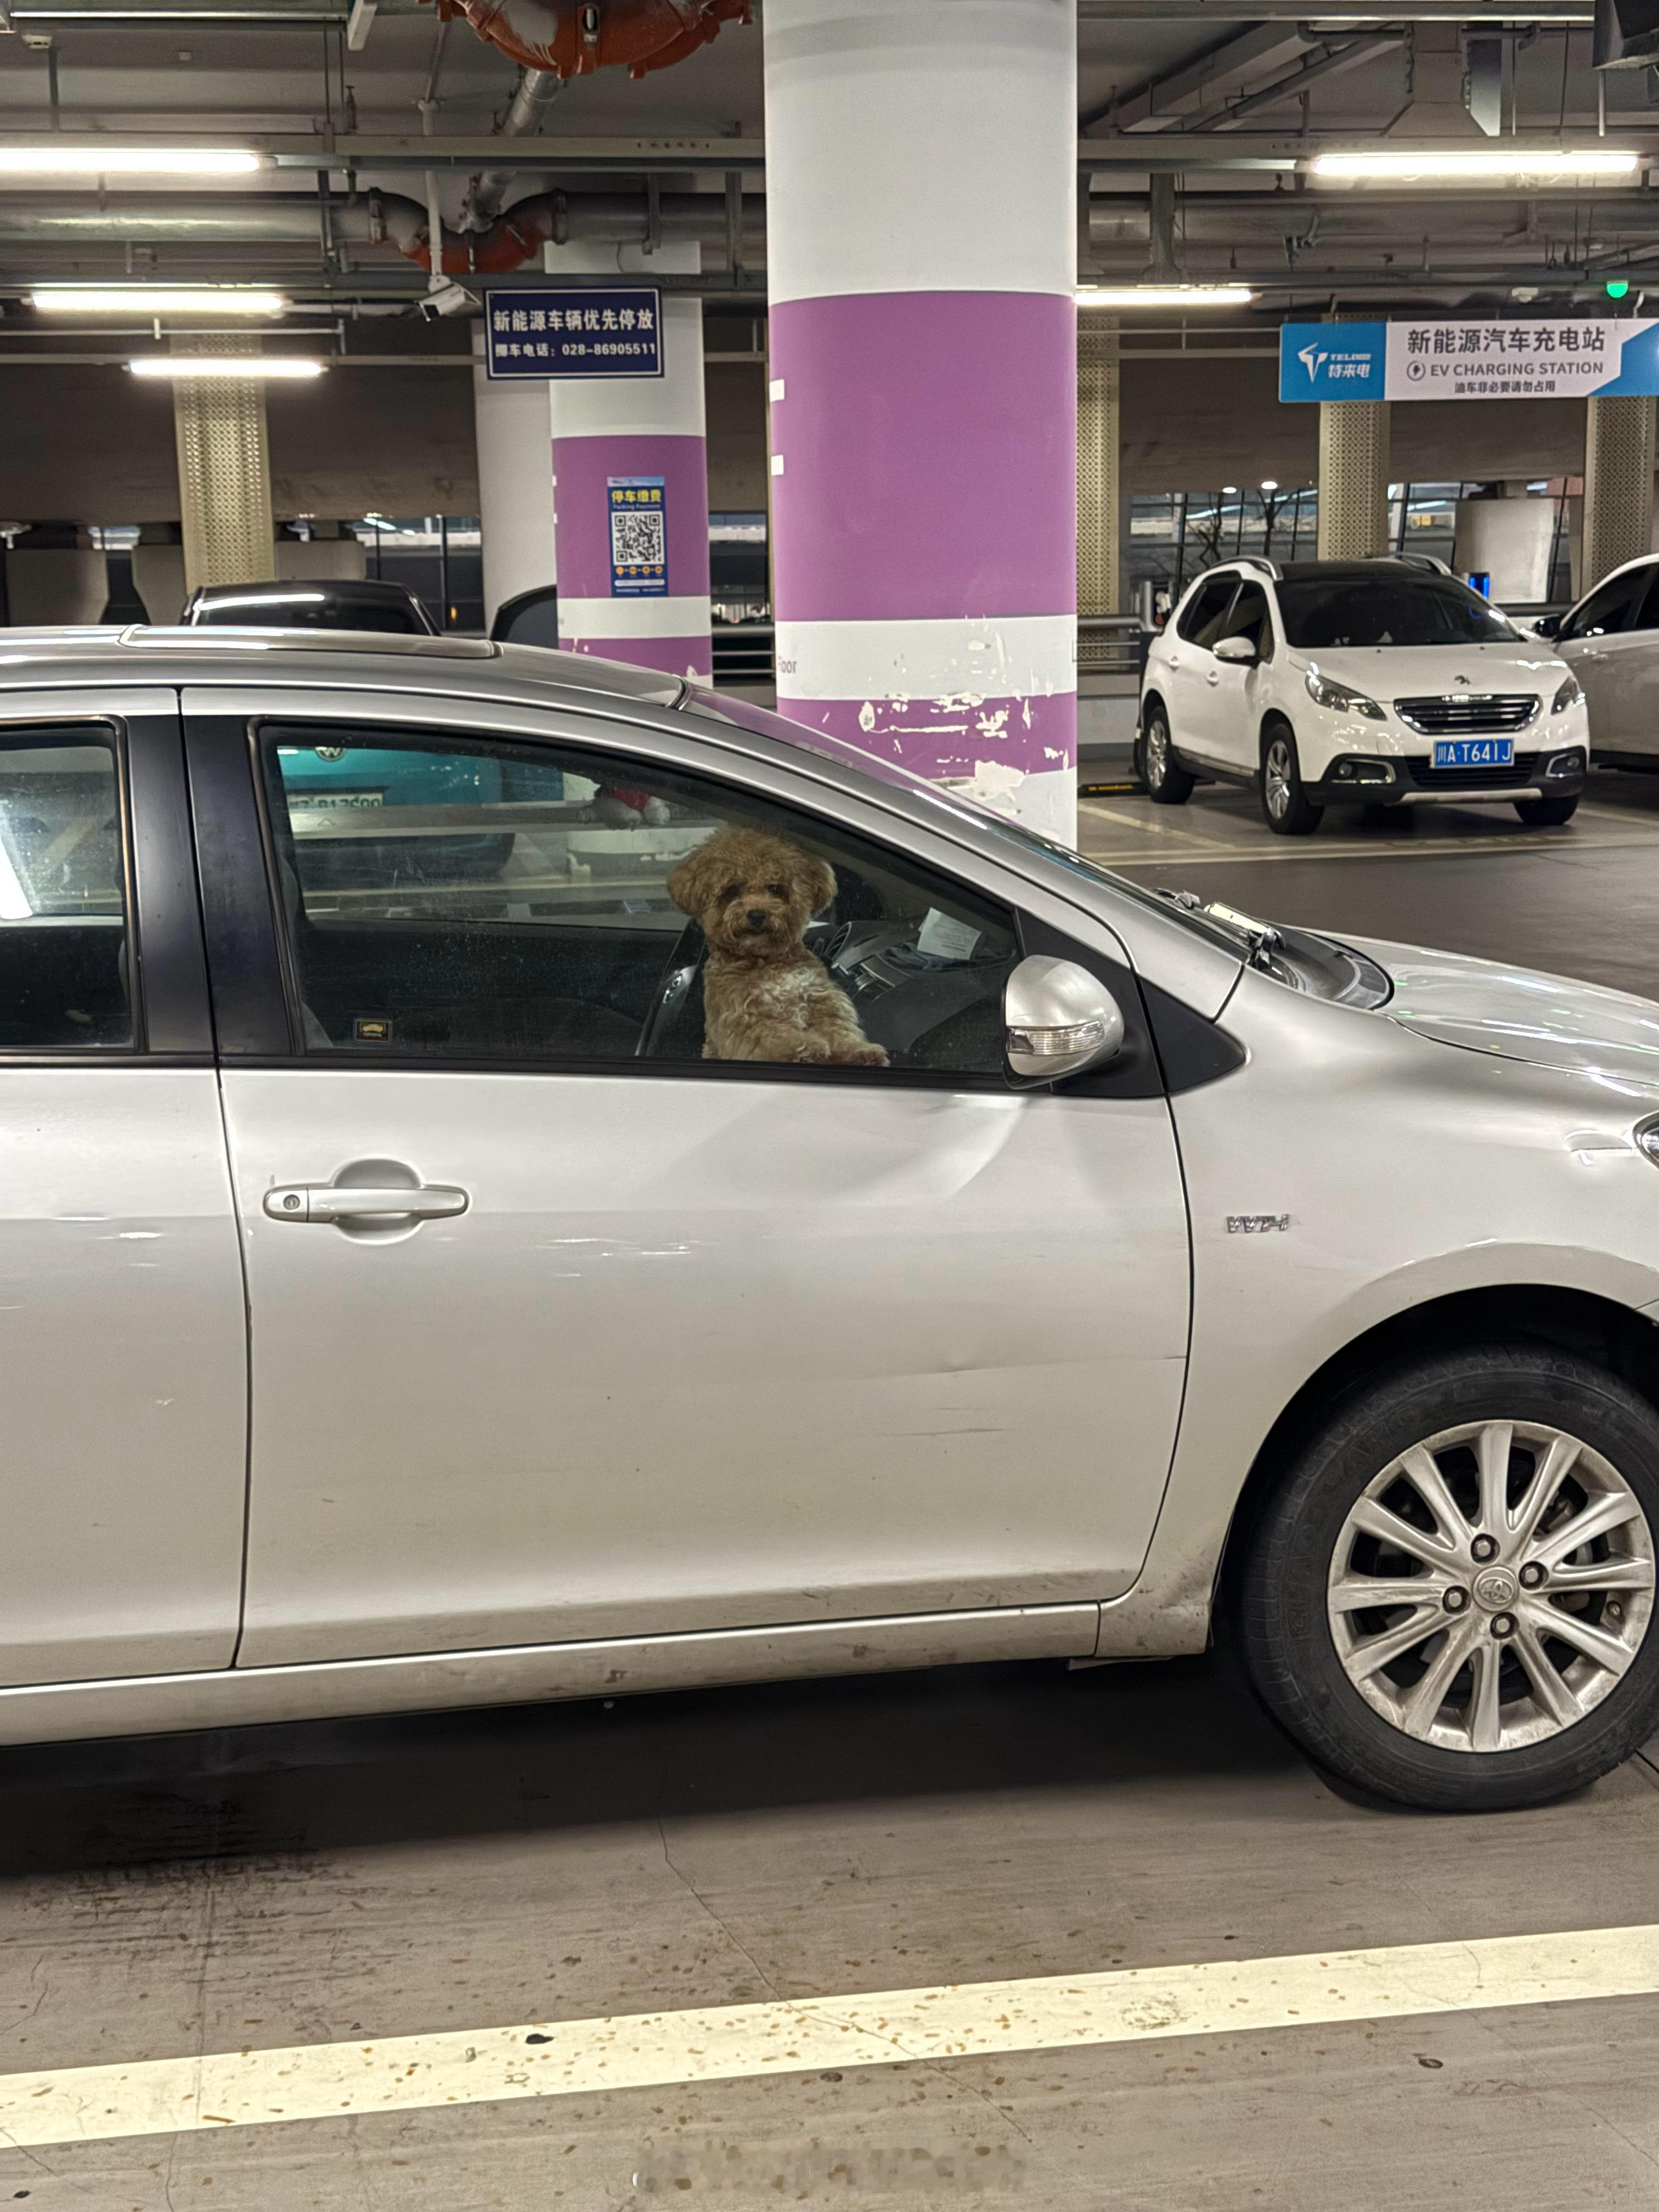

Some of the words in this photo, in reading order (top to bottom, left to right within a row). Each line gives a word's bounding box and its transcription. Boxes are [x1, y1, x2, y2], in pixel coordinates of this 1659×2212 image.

[494, 308, 654, 332] 新能源车辆优先停放
[1407, 326, 1605, 354] 新能源汽车充电站
[562, 343, 656, 356] 028-86905511
[1328, 363, 1370, 378] 特来电
[1430, 364, 1449, 376] EV
[1453, 363, 1534, 376] CHARGING
[1539, 362, 1604, 375] STATION
[1454, 380, 1556, 393] 油车非必要请勿占用
